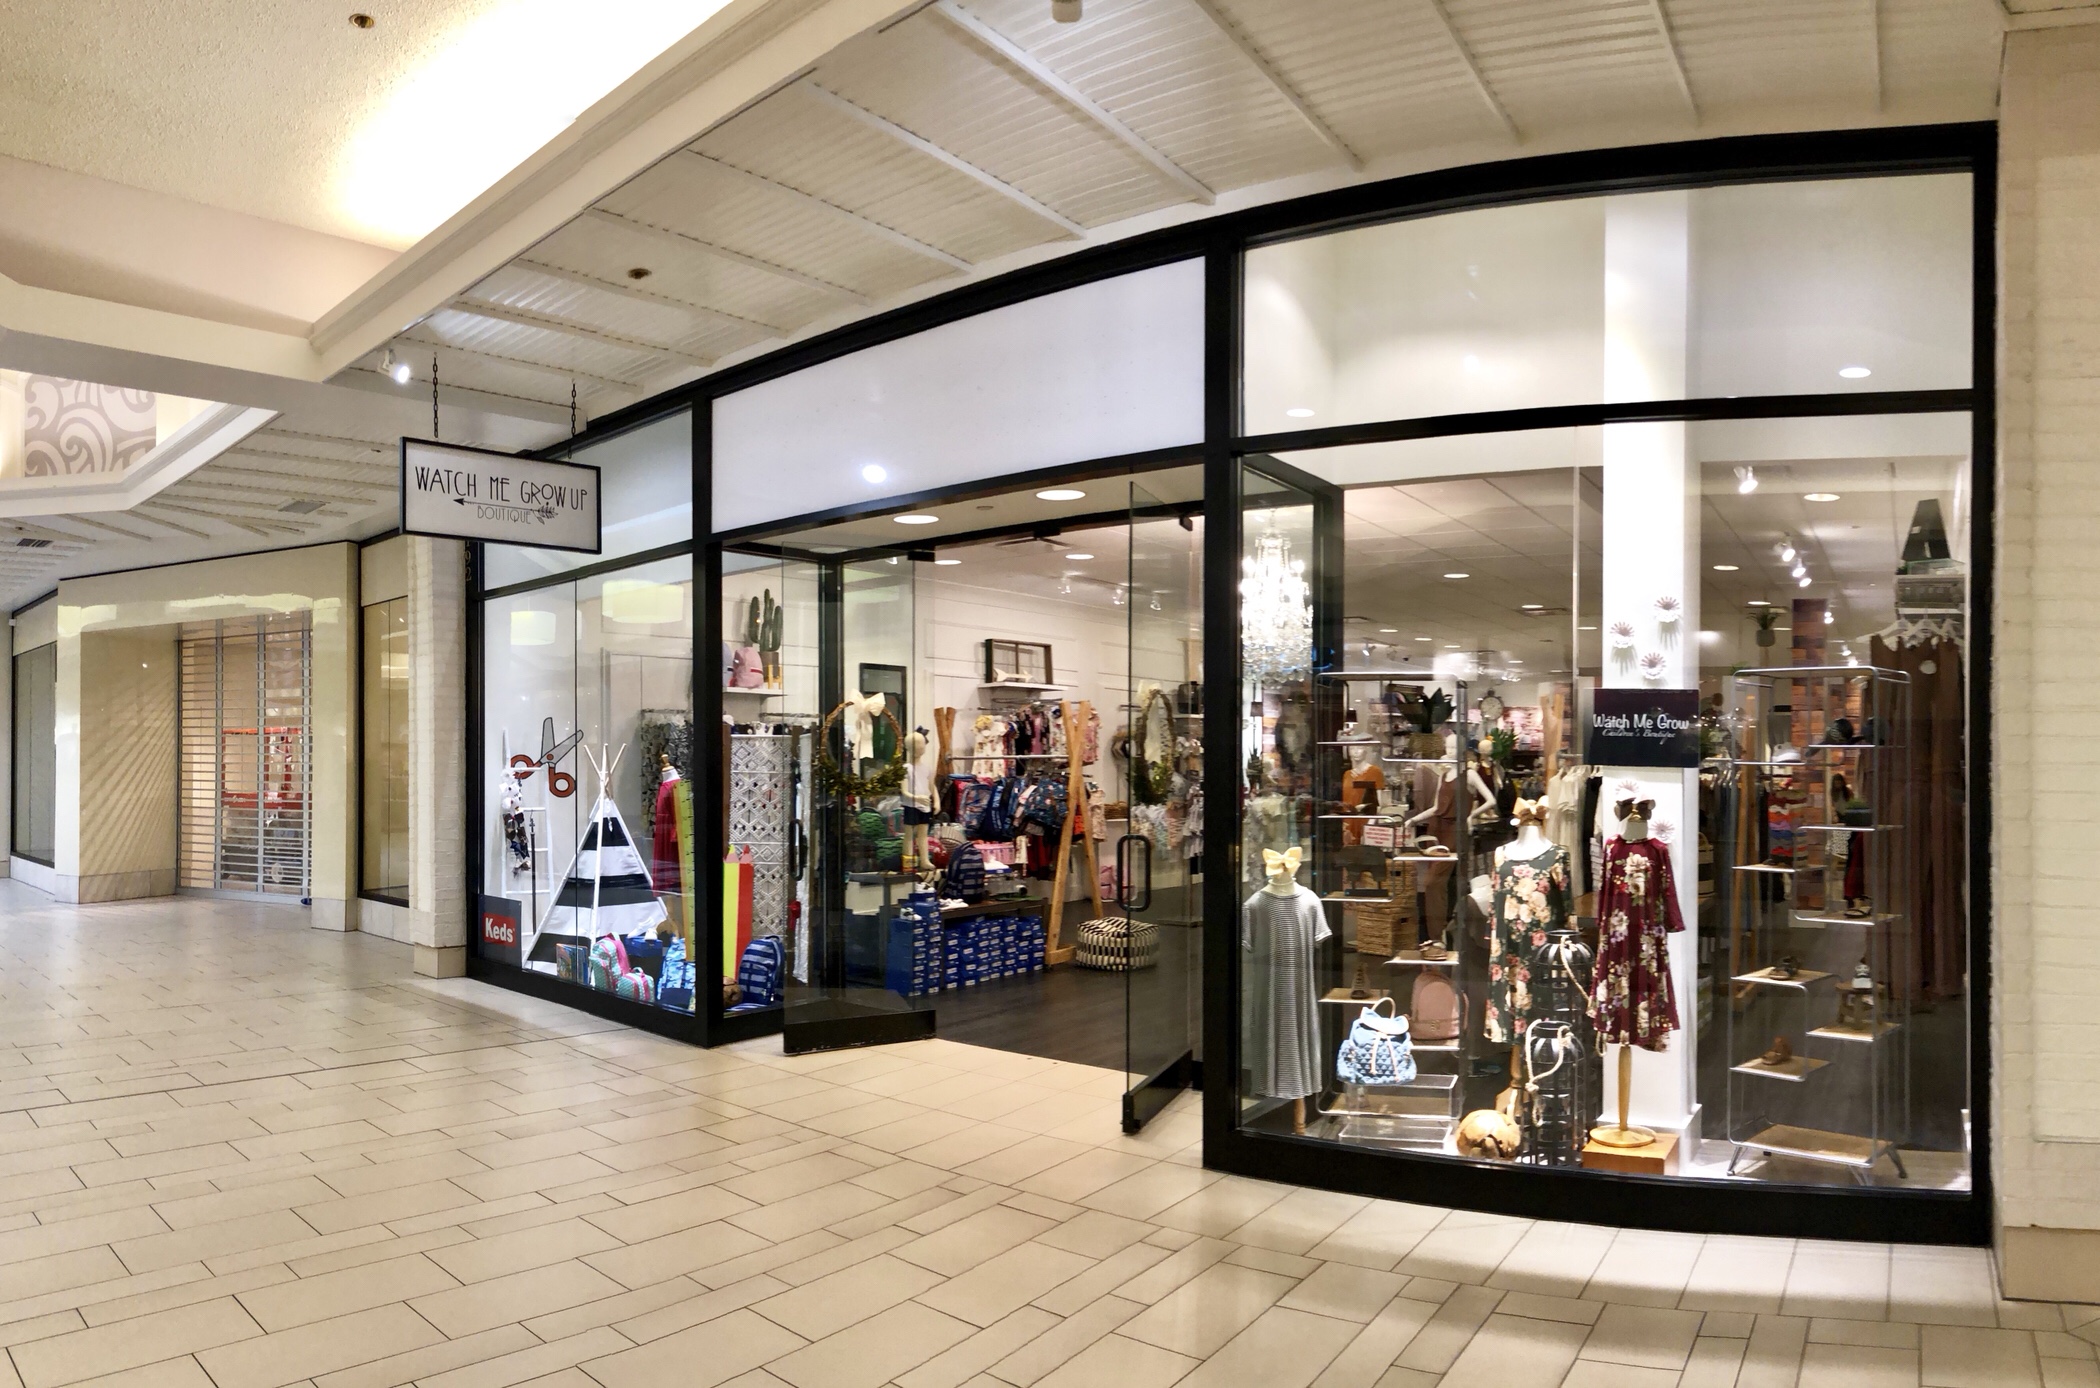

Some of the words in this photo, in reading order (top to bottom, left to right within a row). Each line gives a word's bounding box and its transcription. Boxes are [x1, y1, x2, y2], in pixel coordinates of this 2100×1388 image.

[415, 466, 477, 498] WATCH
[490, 476, 510, 502] ME
[477, 505, 532, 524] BOUTIQUE
[1592, 713, 1630, 729] Watch
[1633, 713, 1653, 729] Me
[1657, 714, 1689, 730] Grow
[485, 917, 514, 943] Keds
